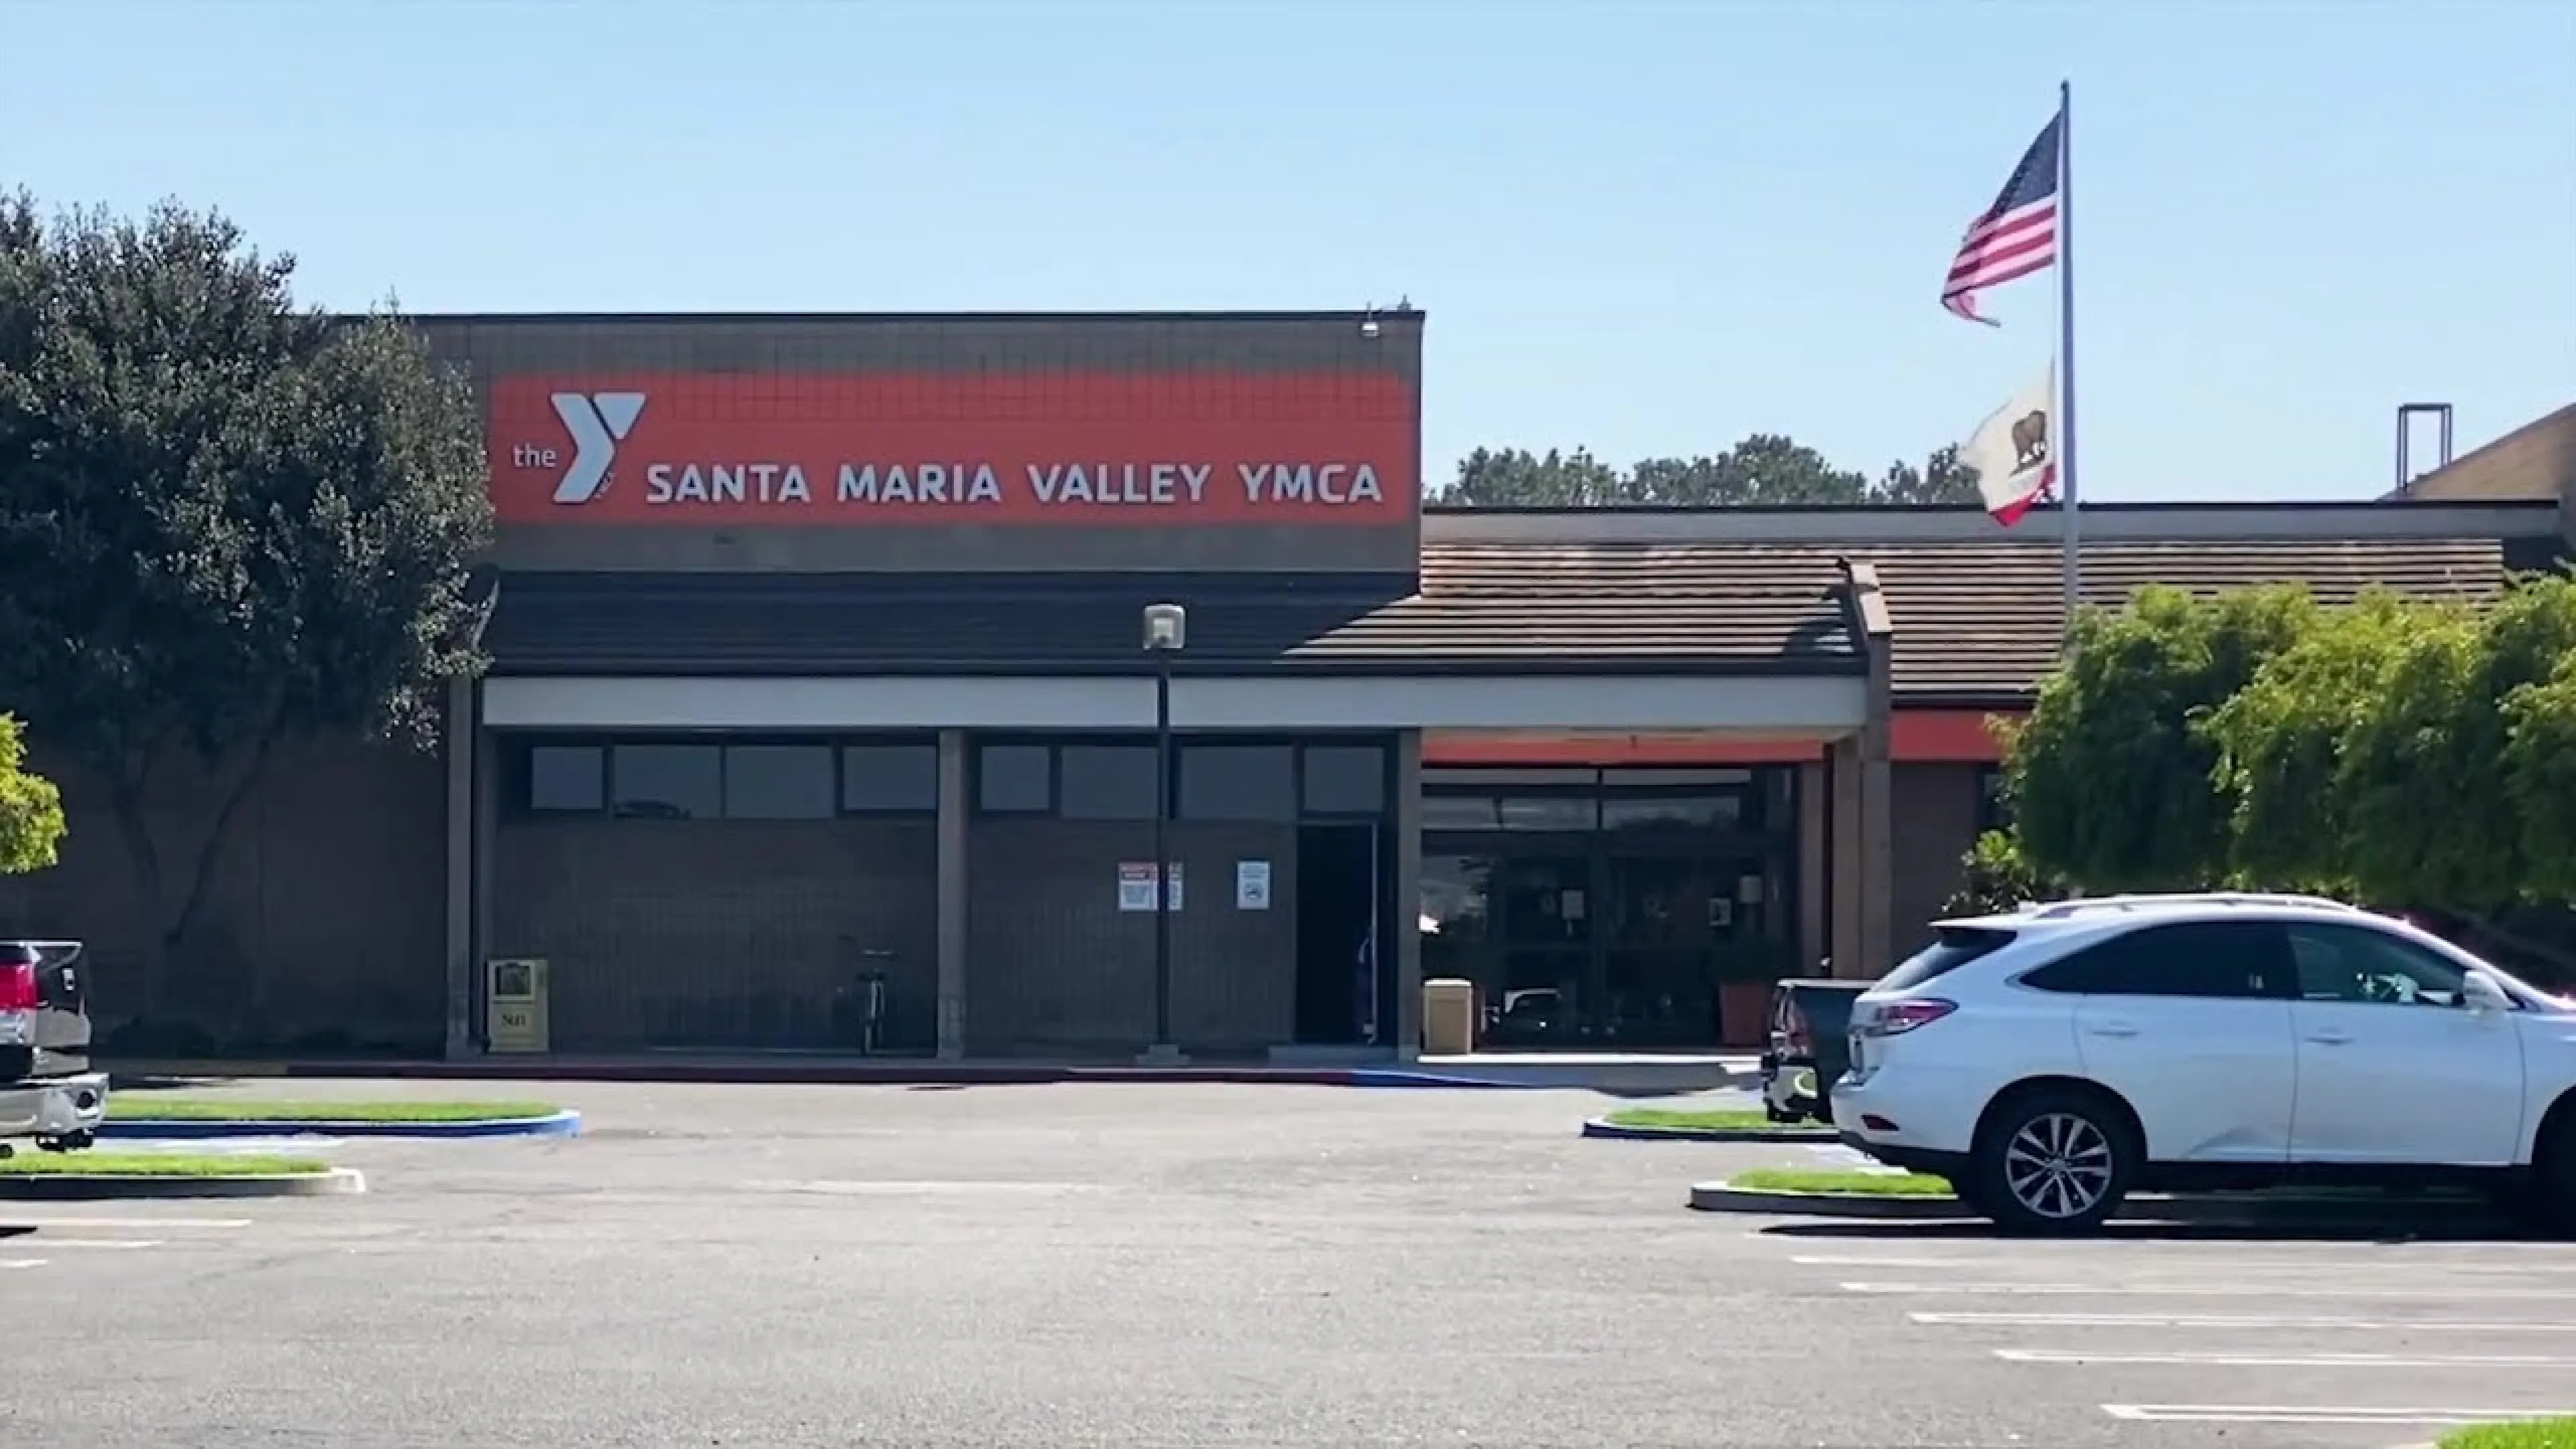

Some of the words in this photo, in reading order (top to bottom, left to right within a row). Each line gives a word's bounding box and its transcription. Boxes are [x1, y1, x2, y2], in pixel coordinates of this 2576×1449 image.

[513, 443, 556, 468] the
[646, 464, 810, 502] SANTA
[837, 464, 1002, 502] MARIA
[1026, 464, 1212, 502] VALLEY
[1238, 464, 1382, 503] YMCA
